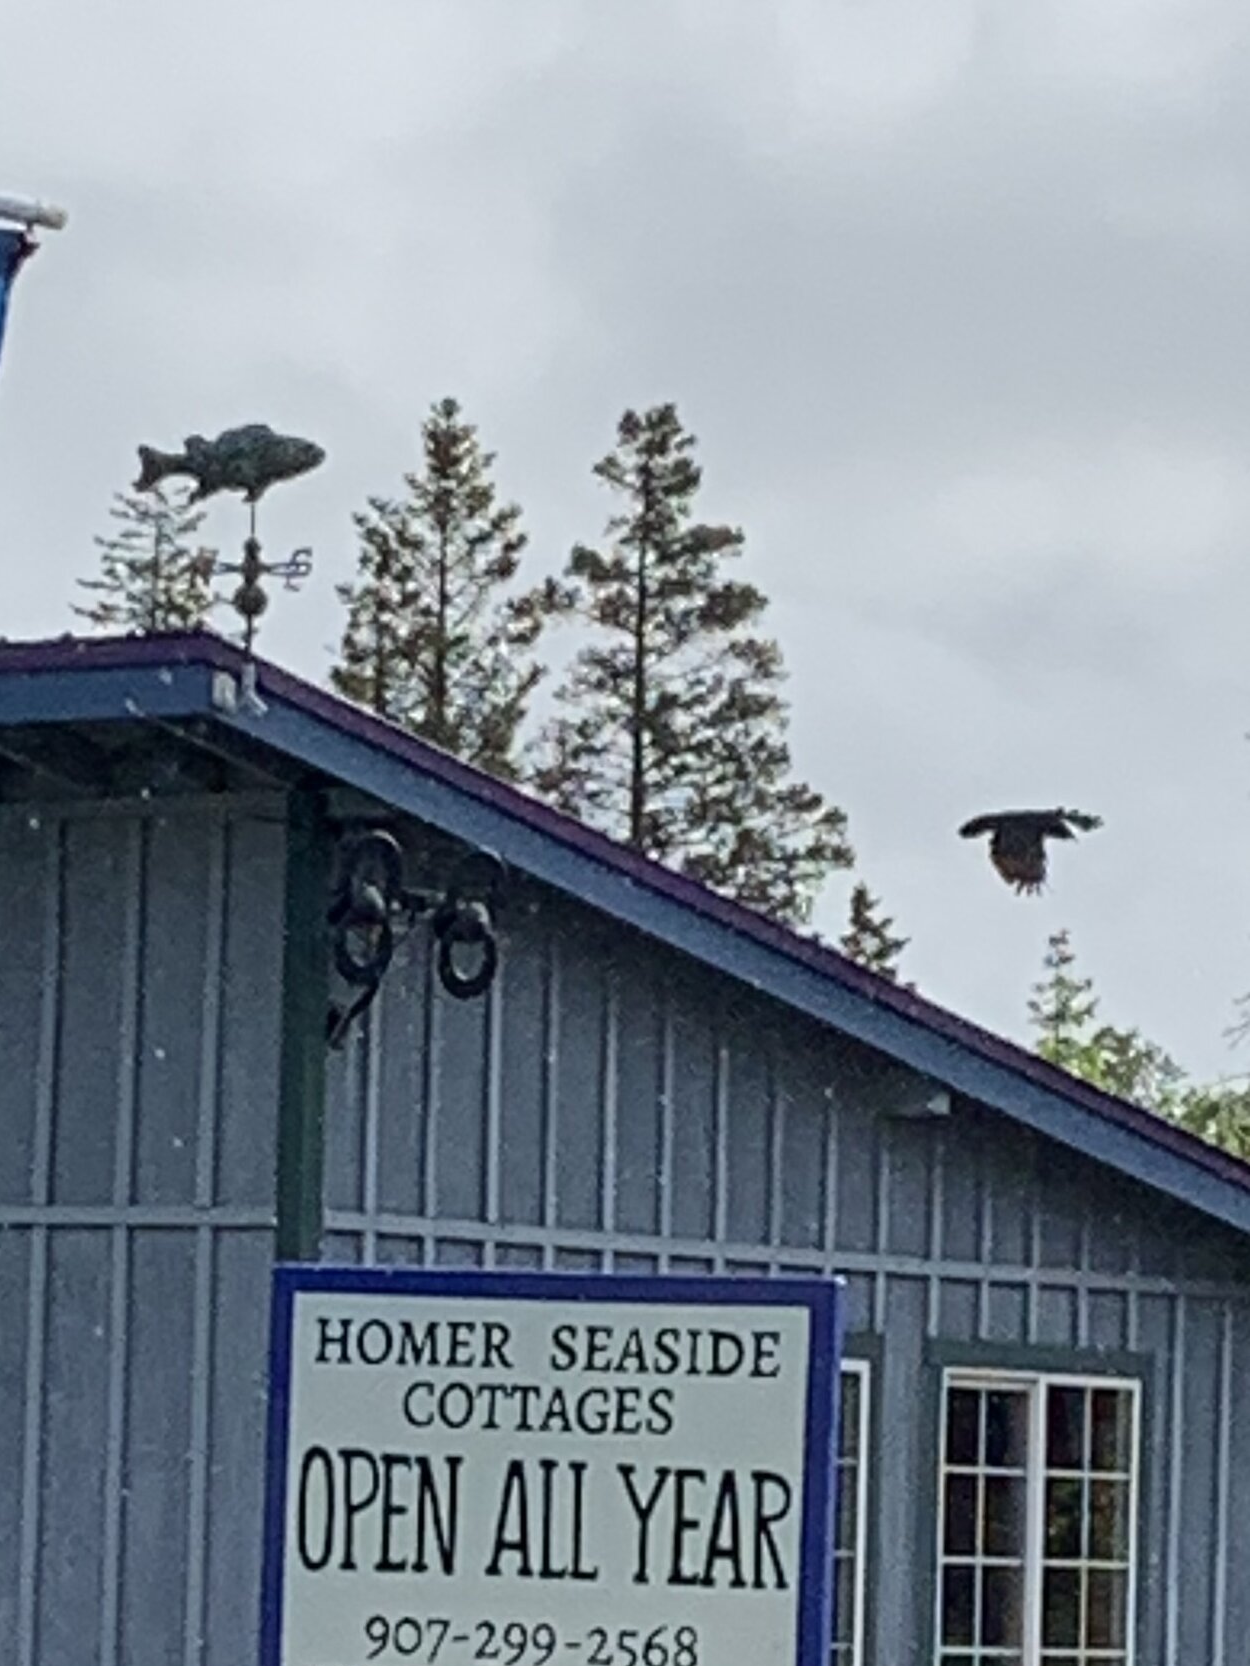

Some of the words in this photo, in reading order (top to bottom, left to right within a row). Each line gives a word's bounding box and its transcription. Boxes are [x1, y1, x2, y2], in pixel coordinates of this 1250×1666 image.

[315, 1317, 514, 1368] HOMER
[551, 1325, 781, 1378] SEASIDE
[403, 1382, 674, 1435] COTTAGES
[298, 1446, 463, 1576] OPEN
[485, 1459, 599, 1581] ALL
[617, 1464, 791, 1590] YEAR
